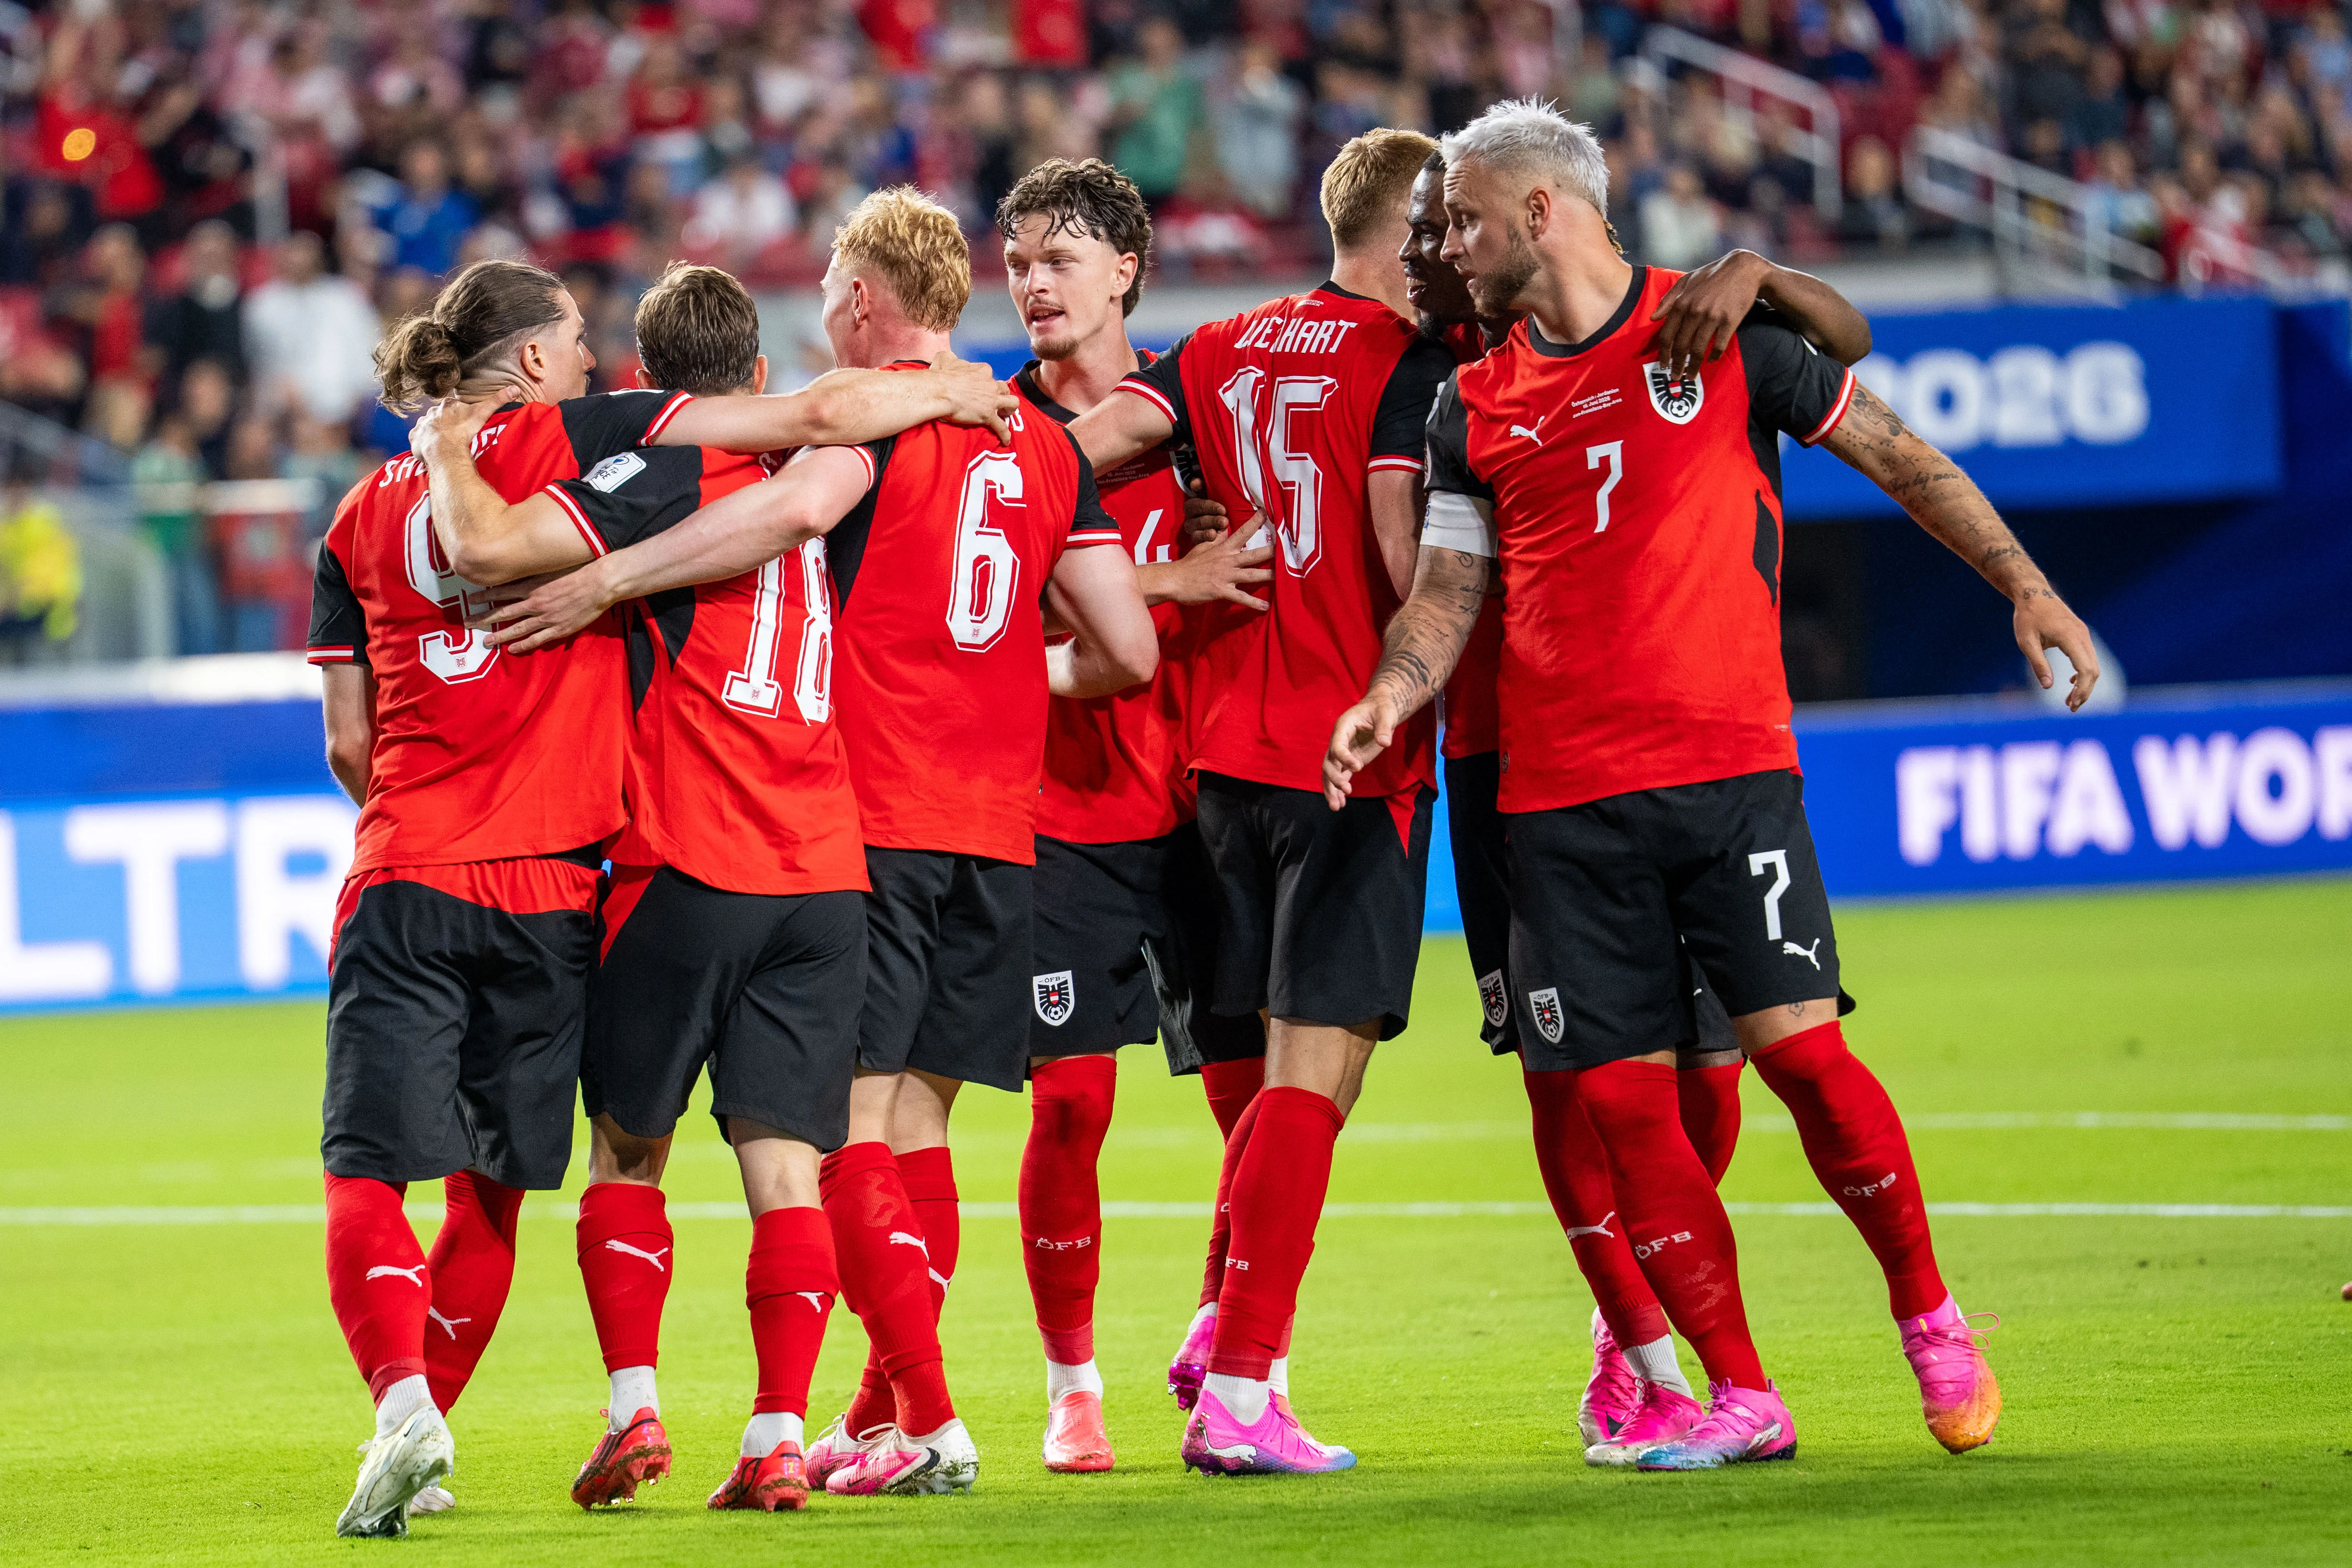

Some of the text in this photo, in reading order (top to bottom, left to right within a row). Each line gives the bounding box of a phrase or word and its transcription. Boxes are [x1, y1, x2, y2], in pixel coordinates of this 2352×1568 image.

[1218, 365, 1339, 579] 15
[1586, 440, 1624, 533] 7
[945, 450, 1027, 653] 6
[721, 534, 834, 726] 18
[1894, 738, 2135, 866] FIFA
[1748, 849, 1791, 941] 7
[1843, 1172, 1896, 1197] ÖFB
[1036, 1236, 1091, 1250] ÖFB
[1225, 1255, 1249, 1271] FB
[1635, 1231, 1694, 1259] ÖFB
